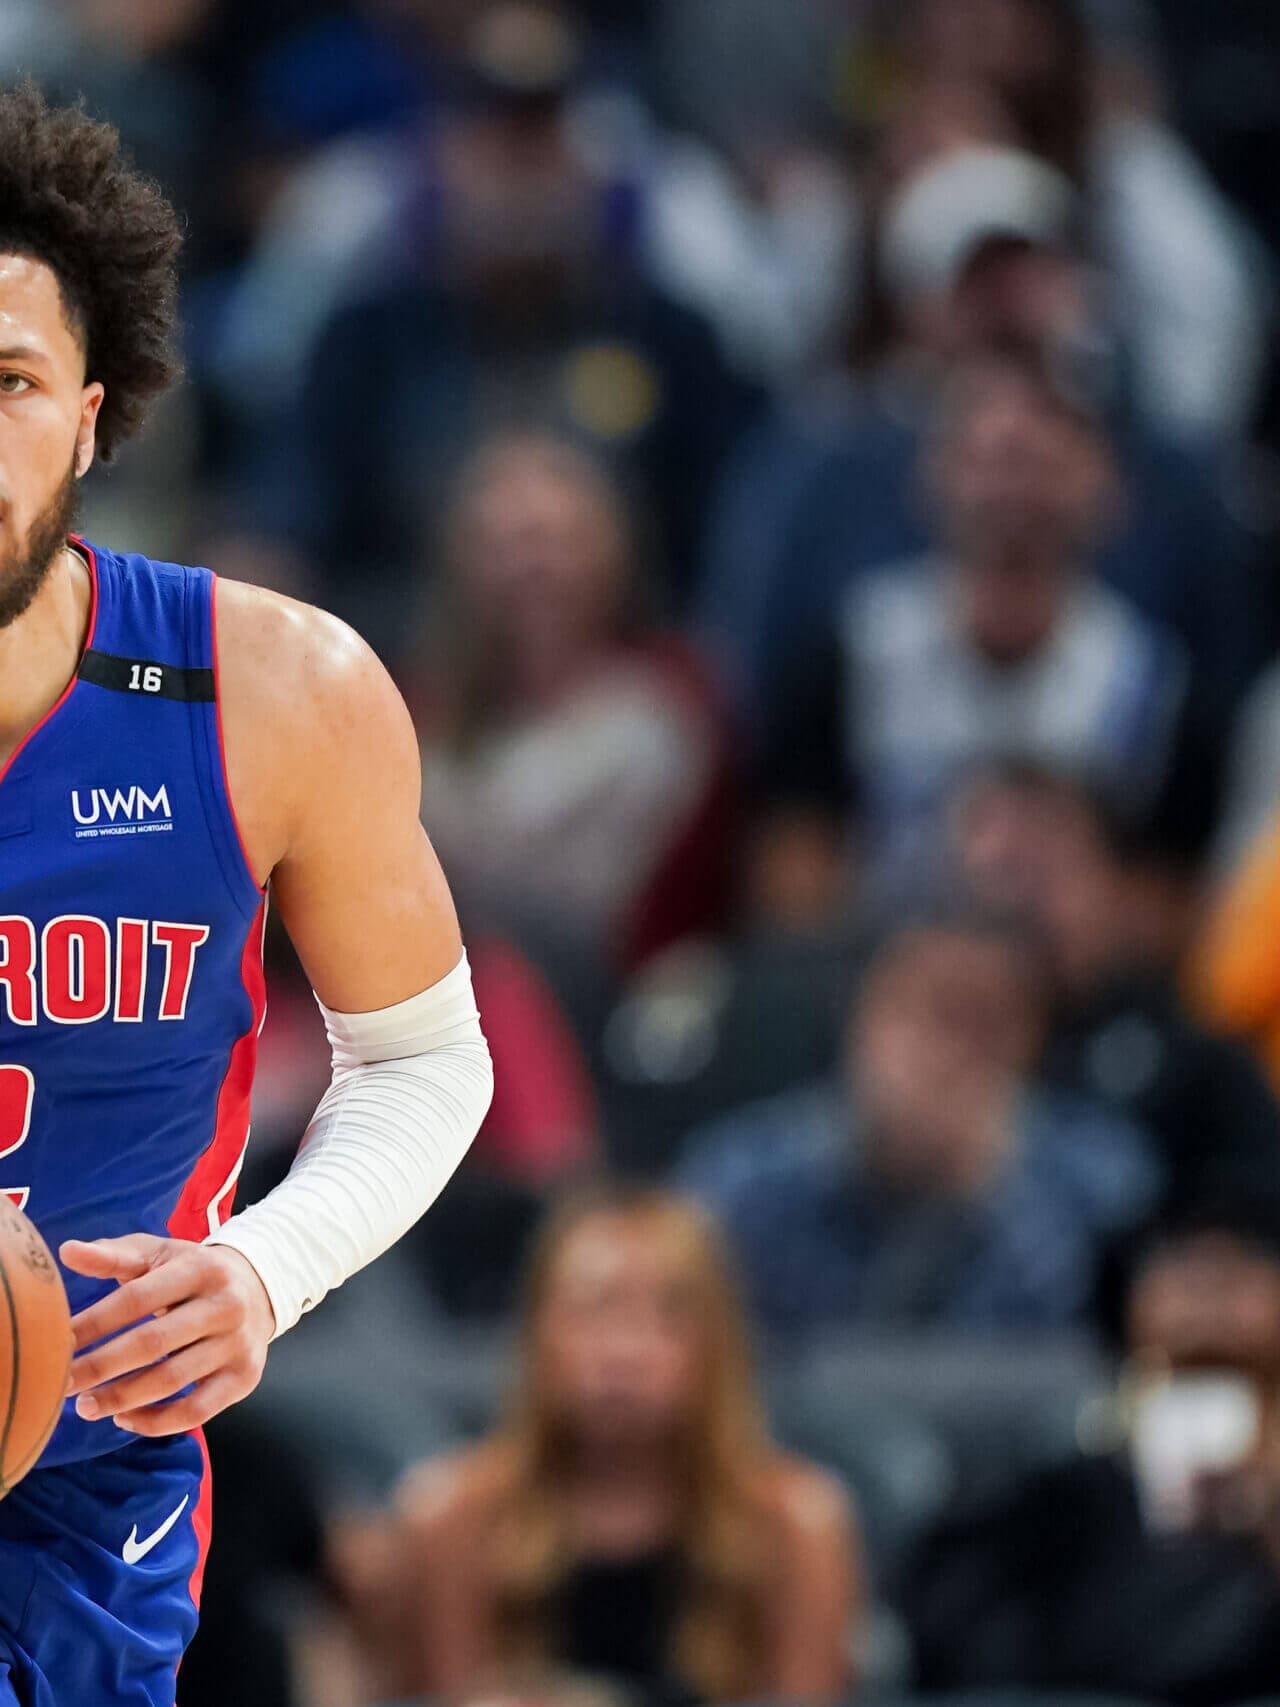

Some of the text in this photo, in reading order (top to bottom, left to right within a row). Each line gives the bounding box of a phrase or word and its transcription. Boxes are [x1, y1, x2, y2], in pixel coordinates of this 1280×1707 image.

[128, 664, 163, 693] 16
[71, 784, 172, 824] UWM
[75, 823, 174, 838] UNITED WHOLESALE MORTGAGE
